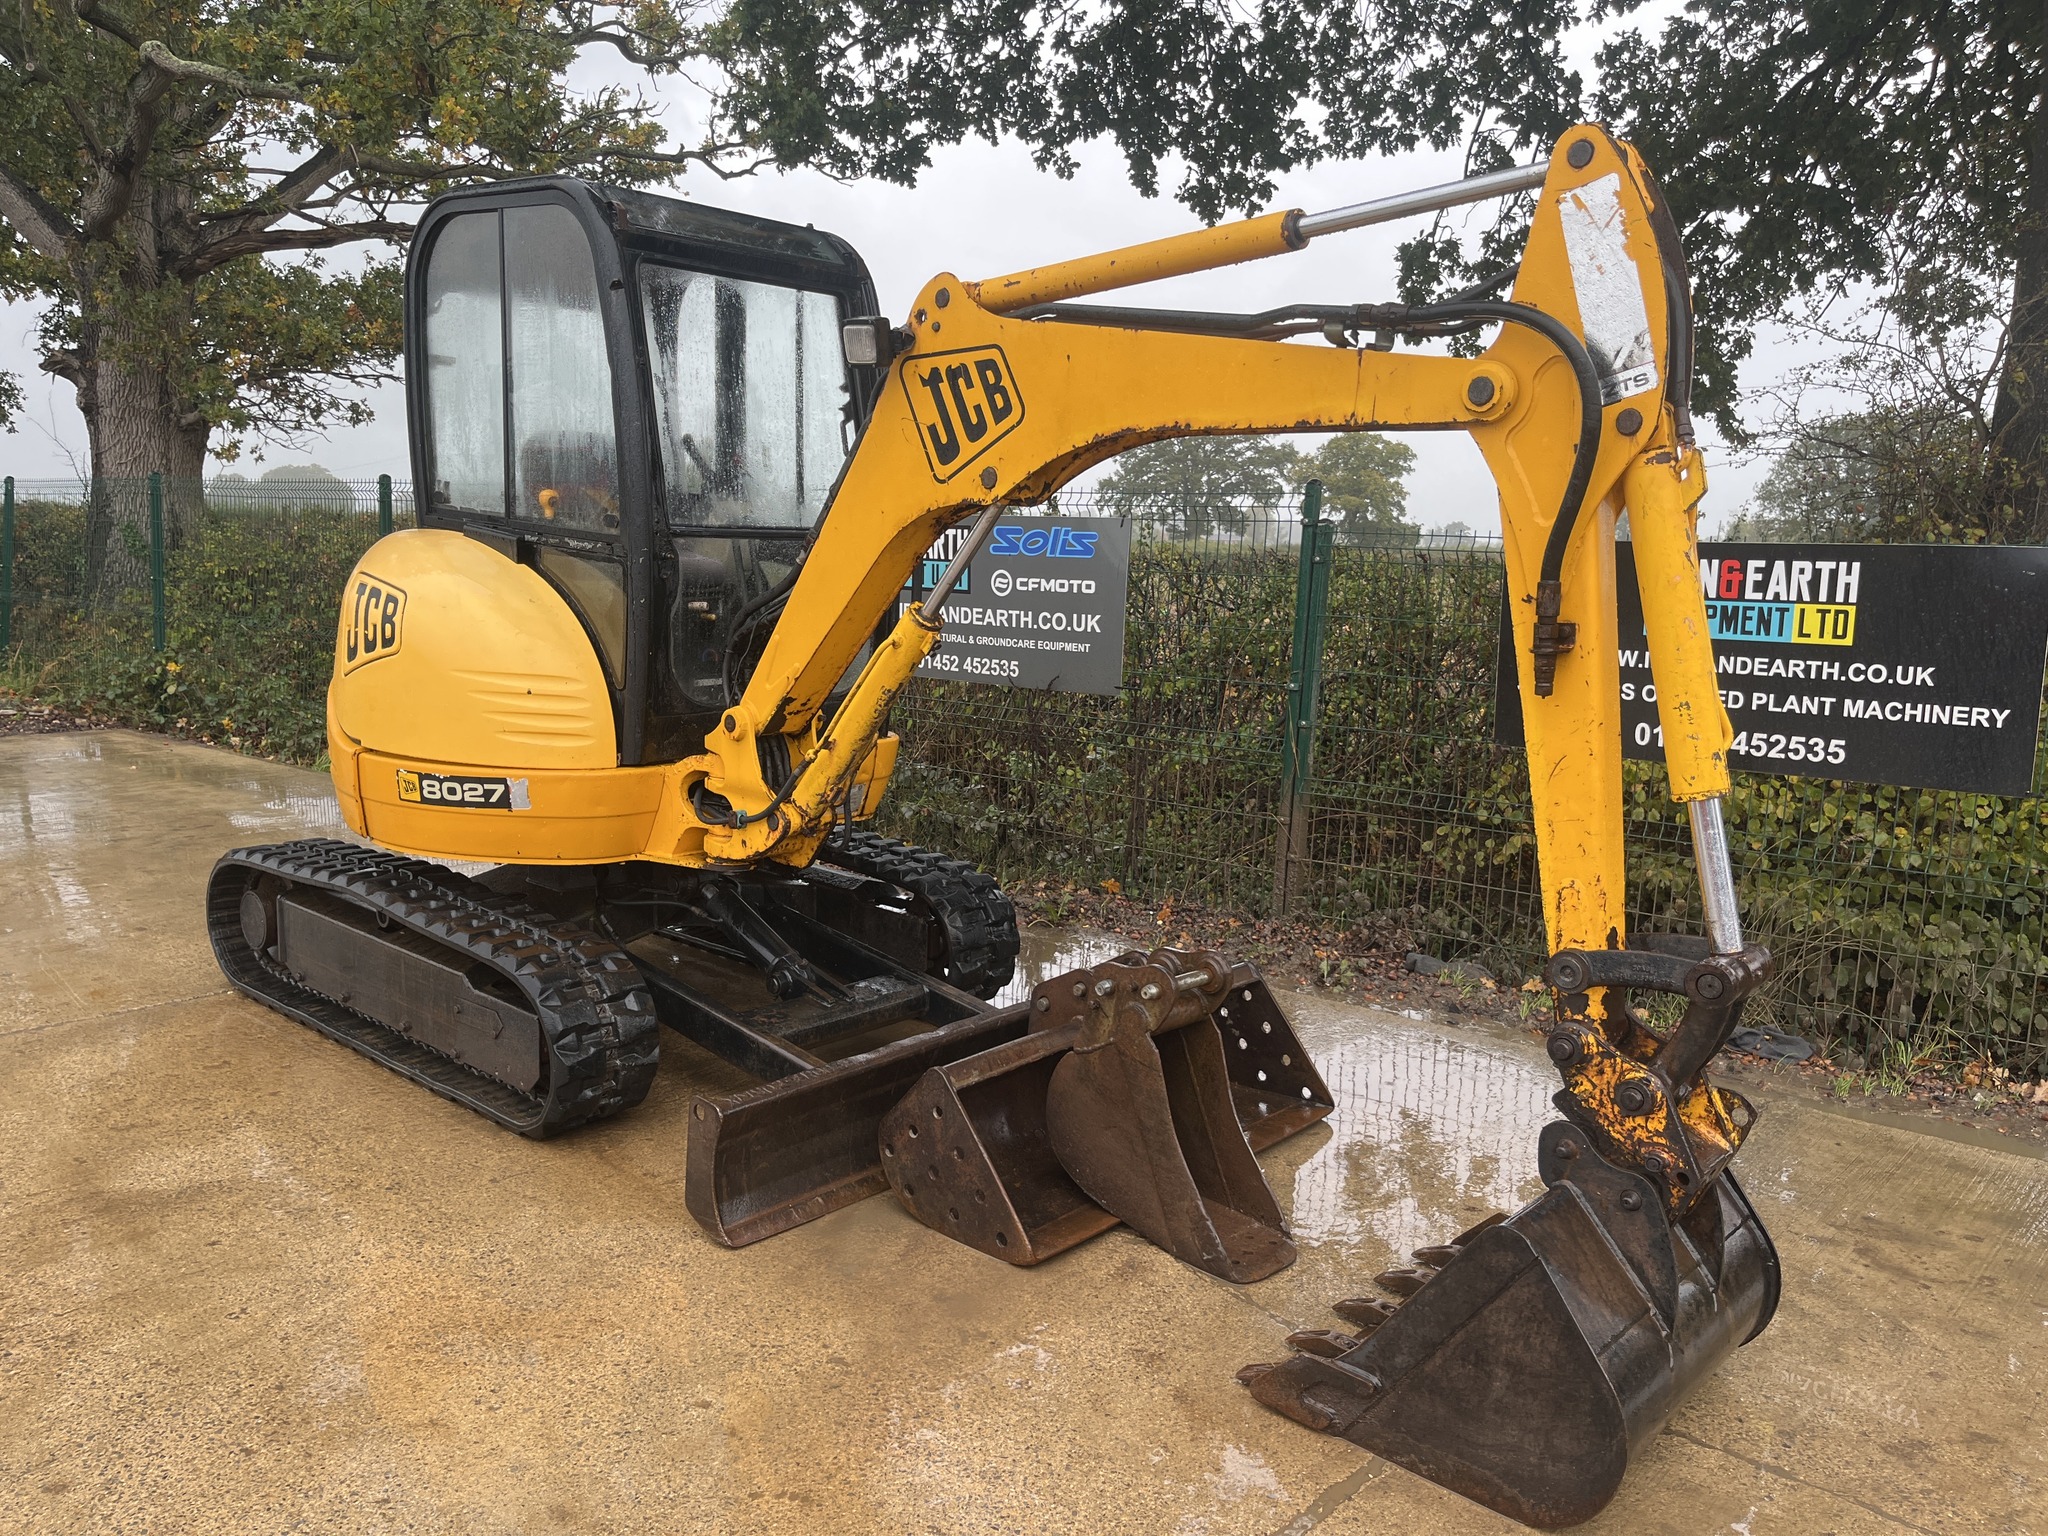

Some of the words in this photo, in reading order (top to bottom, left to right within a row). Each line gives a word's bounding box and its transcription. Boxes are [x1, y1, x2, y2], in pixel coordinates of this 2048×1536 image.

[918, 359, 1013, 466] JCB
[1015, 577, 1096, 594] CFMOTO
[346, 582, 399, 663] JCB
[1798, 608, 1849, 640] LTD
[940, 633, 967, 645] TURAL
[968, 635, 975, 645] &
[976, 636, 1036, 650] GROUNDCARE
[1037, 640, 1091, 653] EQUIPMENT
[963, 656, 1019, 678] 452535
[1751, 692, 1836, 717] PLANT
[1842, 698, 2011, 729] MACHINERY
[1730, 731, 1847, 764] 452535
[402, 778, 418, 794] JCB
[421, 779, 506, 803] 8027
